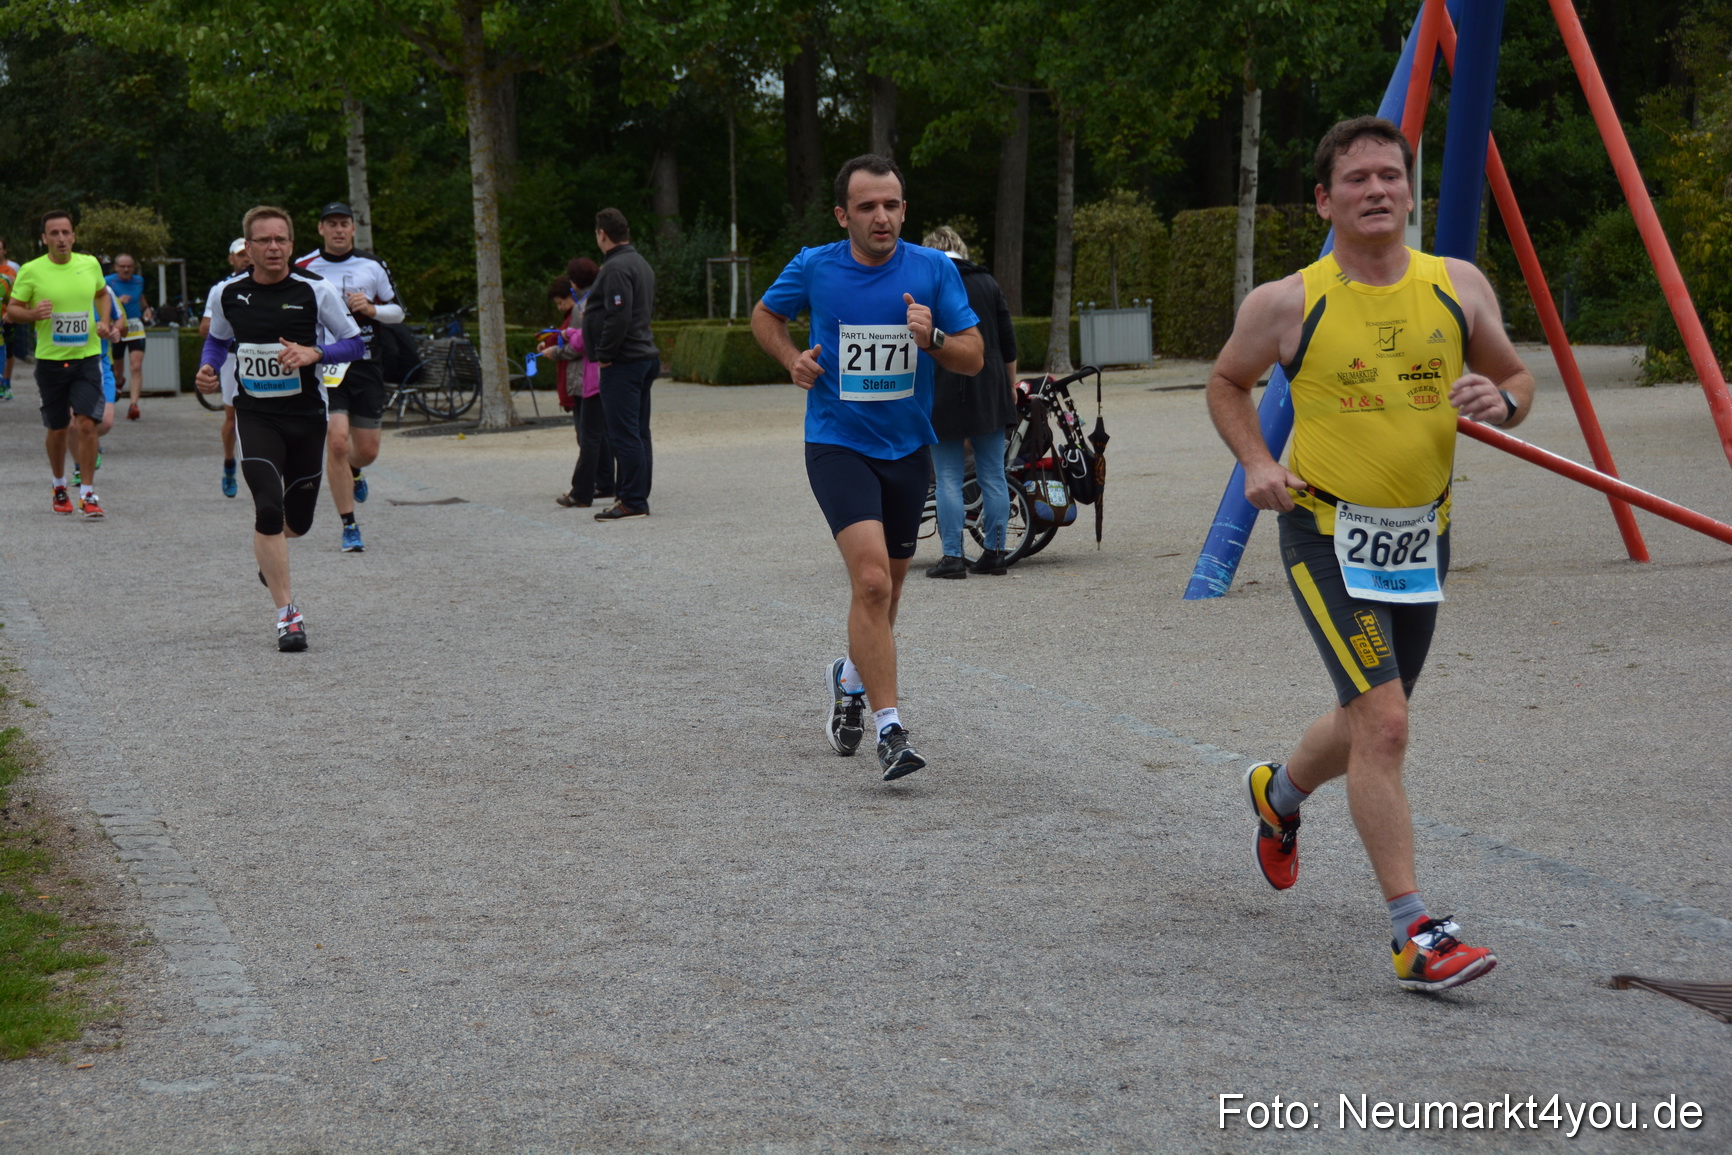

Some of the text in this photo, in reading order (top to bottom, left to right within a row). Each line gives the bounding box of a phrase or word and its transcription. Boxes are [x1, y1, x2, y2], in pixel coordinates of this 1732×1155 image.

[56, 320, 87, 333] 2780
[841, 332, 907, 340] PARTL Neumarkt
[847, 343, 909, 371] 2171
[244, 357, 293, 378] 206
[1337, 368, 1379, 382] NEUMARKTER
[253, 382, 286, 390] Michael
[863, 379, 896, 391] Stefan
[1406, 385, 1441, 398] PIZZERIA
[1340, 394, 1385, 409] M & S
[1413, 395, 1440, 405] ELIO
[1339, 511, 1425, 528] PARTL Neumarkt
[1347, 527, 1430, 567] 2682
[1372, 575, 1406, 590] Klaus
[1360, 614, 1388, 652] Run!
[1357, 636, 1375, 664] Team
